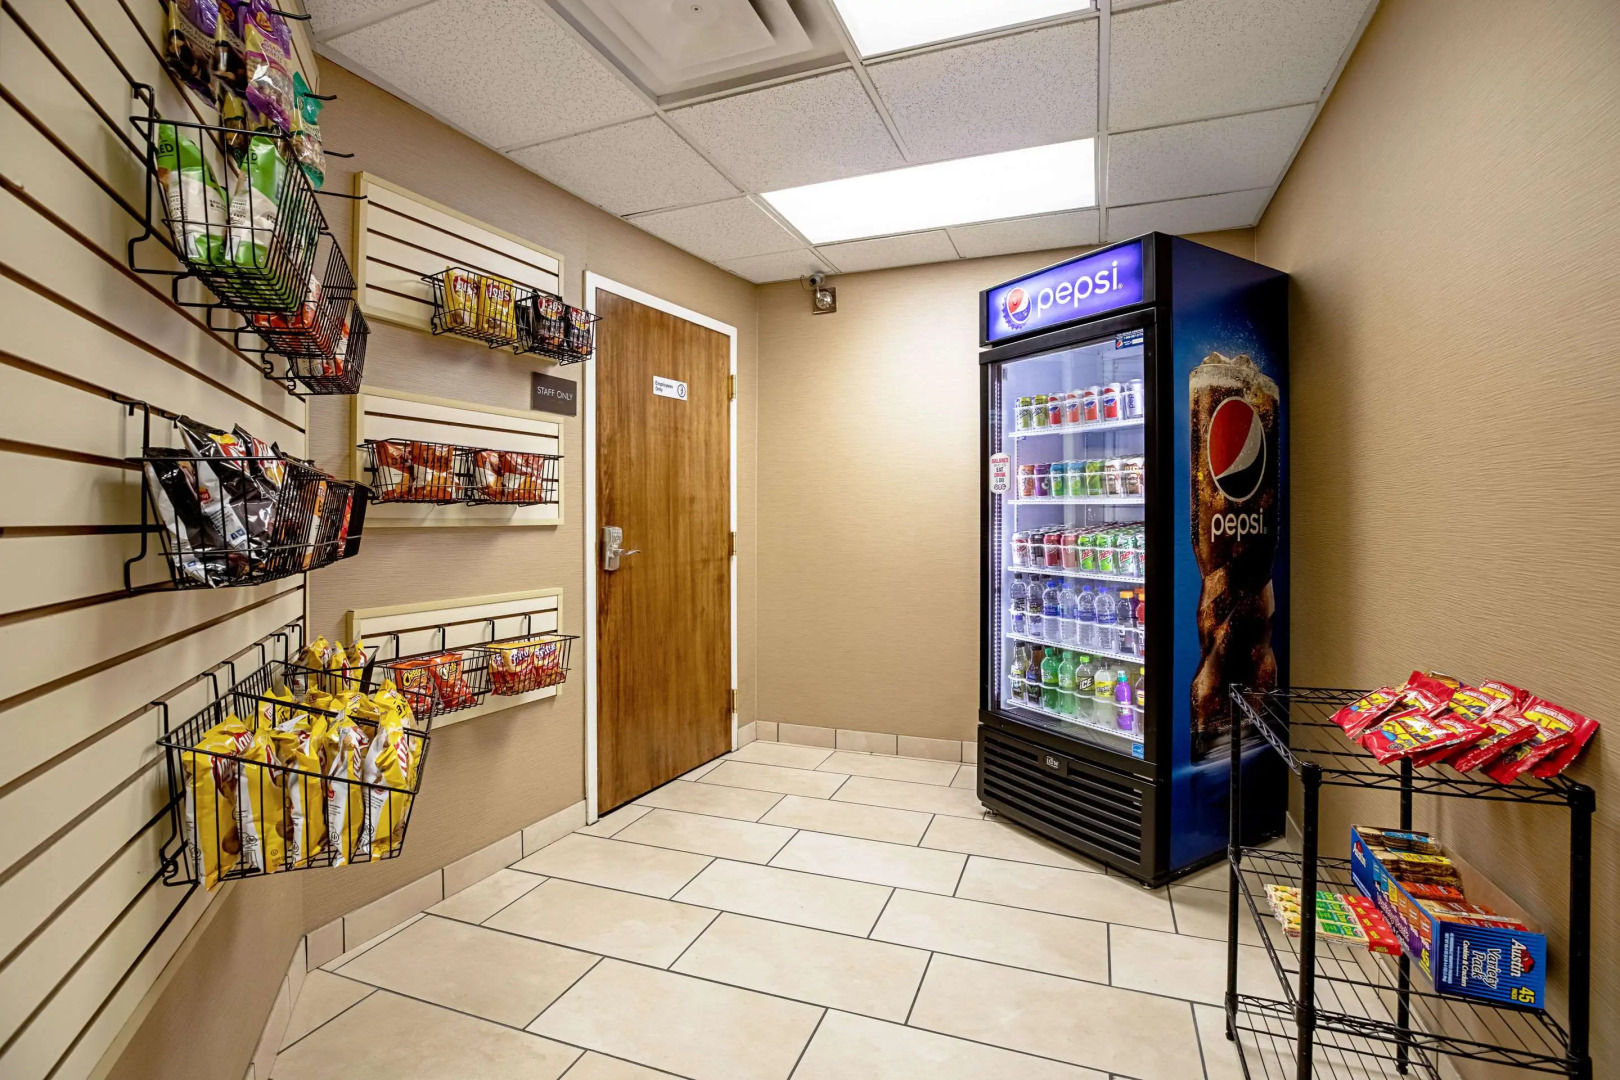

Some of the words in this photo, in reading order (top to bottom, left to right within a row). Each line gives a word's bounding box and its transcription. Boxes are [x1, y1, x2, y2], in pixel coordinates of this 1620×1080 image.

[1037, 260, 1118, 319] pepsi
[537, 385, 555, 397] STAFF
[556, 390, 573, 401] ONLY
[1211, 507, 1263, 542] pepsi
[1462, 940, 1470, 960] Cookies
[1471, 950, 1487, 979] Pack
[1510, 937, 1527, 977] Austin
[1461, 965, 1469, 987] Crackers
[1482, 948, 1501, 989] Variety
[1518, 986, 1535, 1004] 45
